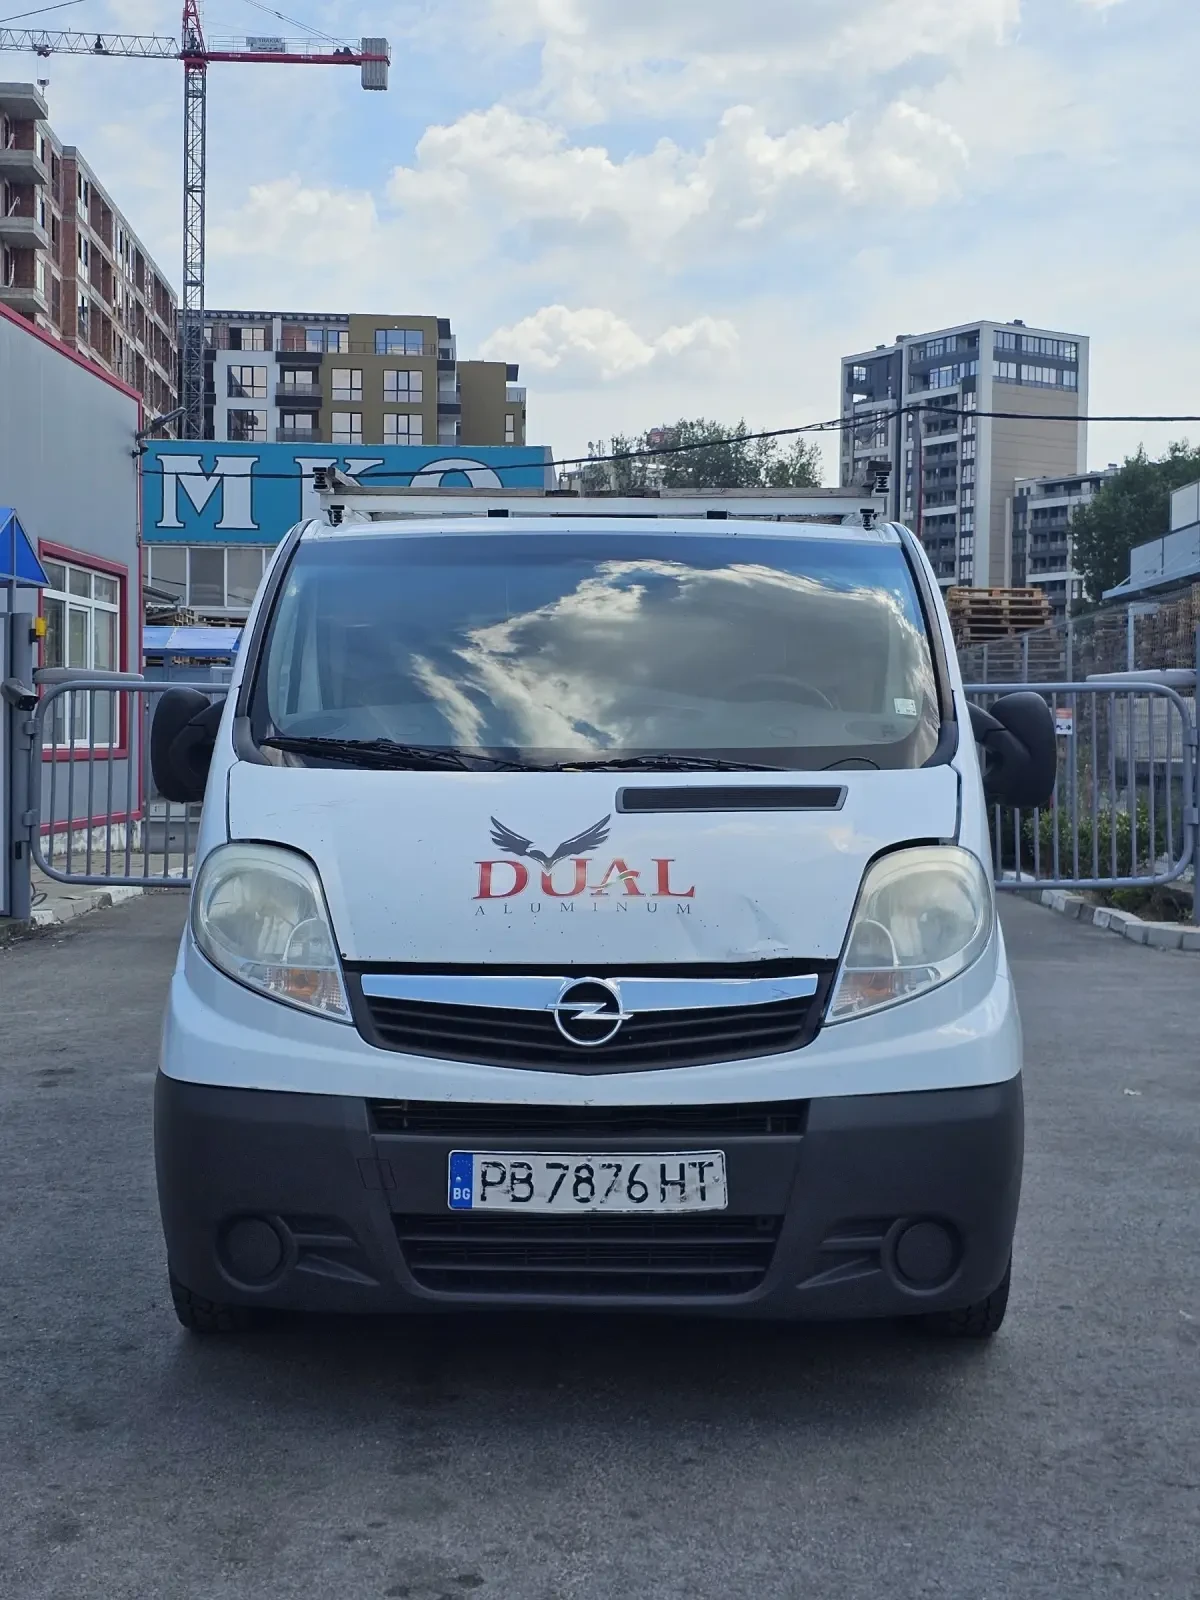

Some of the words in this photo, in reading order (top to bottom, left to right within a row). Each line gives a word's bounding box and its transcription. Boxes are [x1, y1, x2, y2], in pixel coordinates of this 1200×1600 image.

[472, 858, 695, 900] DUAL
[475, 902, 692, 916] ALUMINUM
[453, 1187, 471, 1200] BG
[480, 1161, 534, 1202] PB
[545, 1162, 649, 1204] 7876
[660, 1161, 714, 1202] HT
